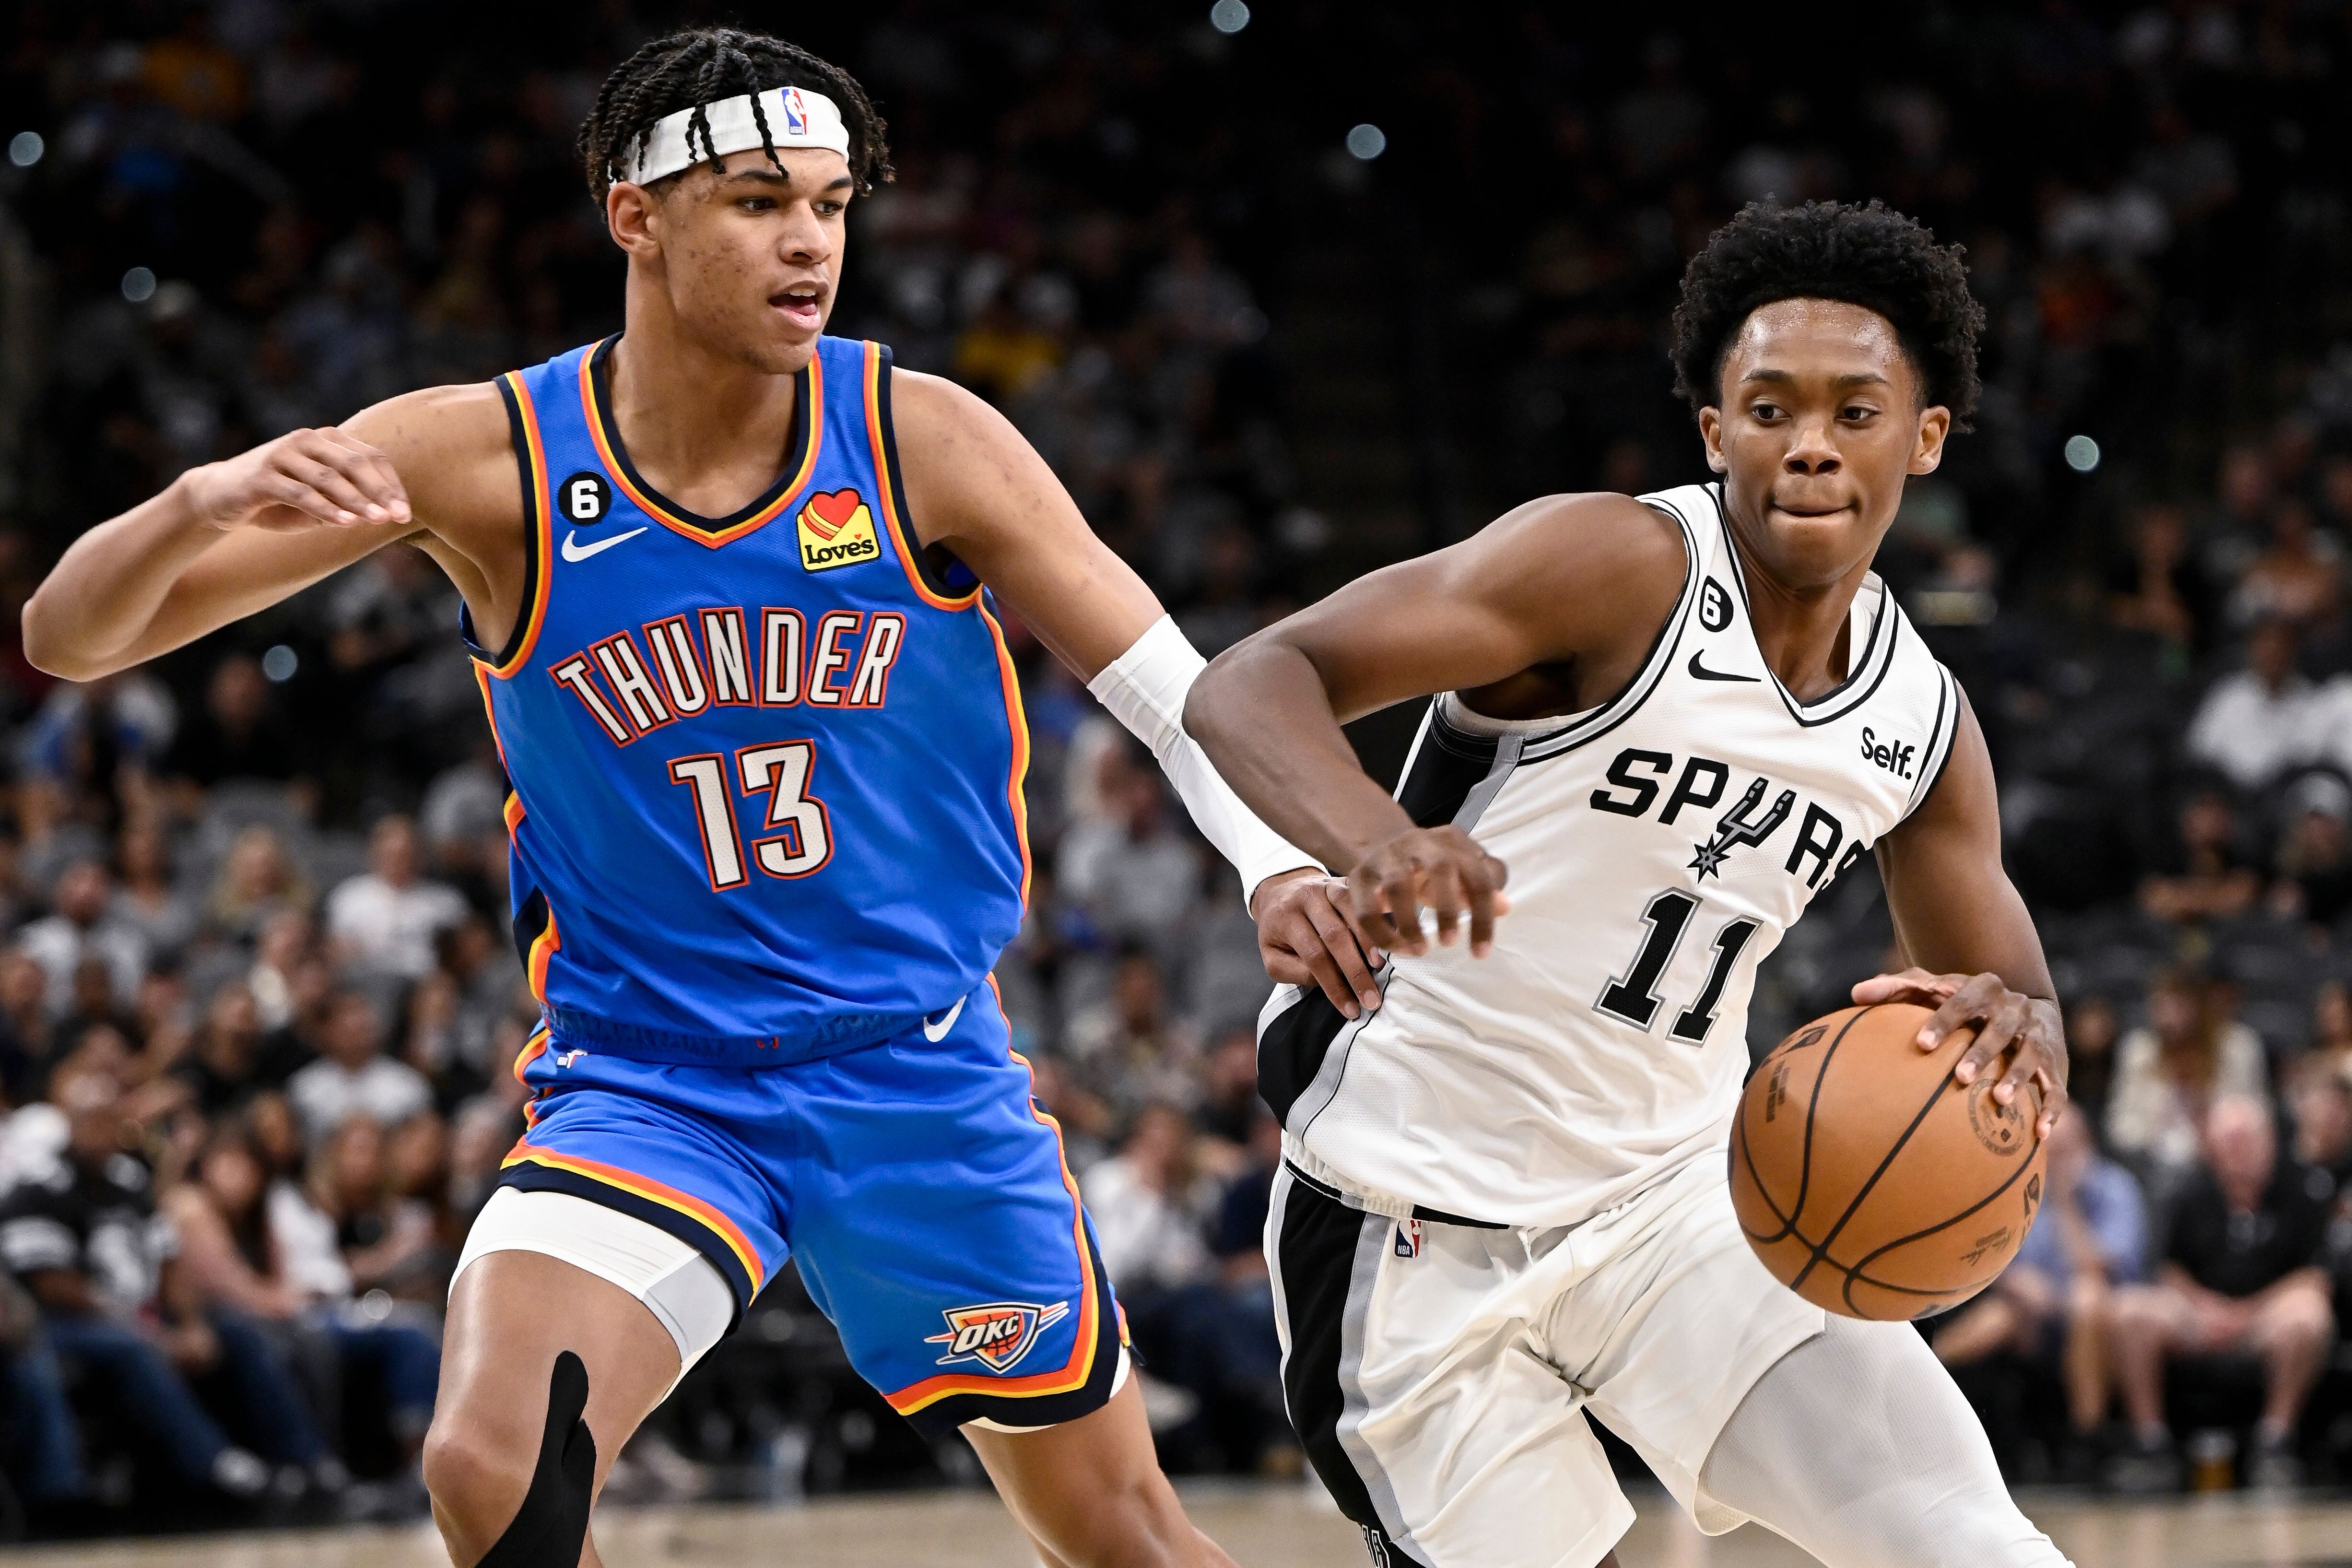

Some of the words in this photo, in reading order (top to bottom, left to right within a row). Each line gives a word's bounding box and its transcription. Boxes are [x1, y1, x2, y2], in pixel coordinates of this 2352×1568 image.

[571, 480, 599, 519] 6
[1702, 583, 1721, 626] 6
[547, 606, 906, 748] THUNDER
[1861, 726, 1915, 780] Self.
[667, 739, 834, 892] 13
[1592, 886, 1763, 1048] 11
[1398, 1244, 1410, 1255] NBA
[953, 1315, 1020, 1354] OKC
